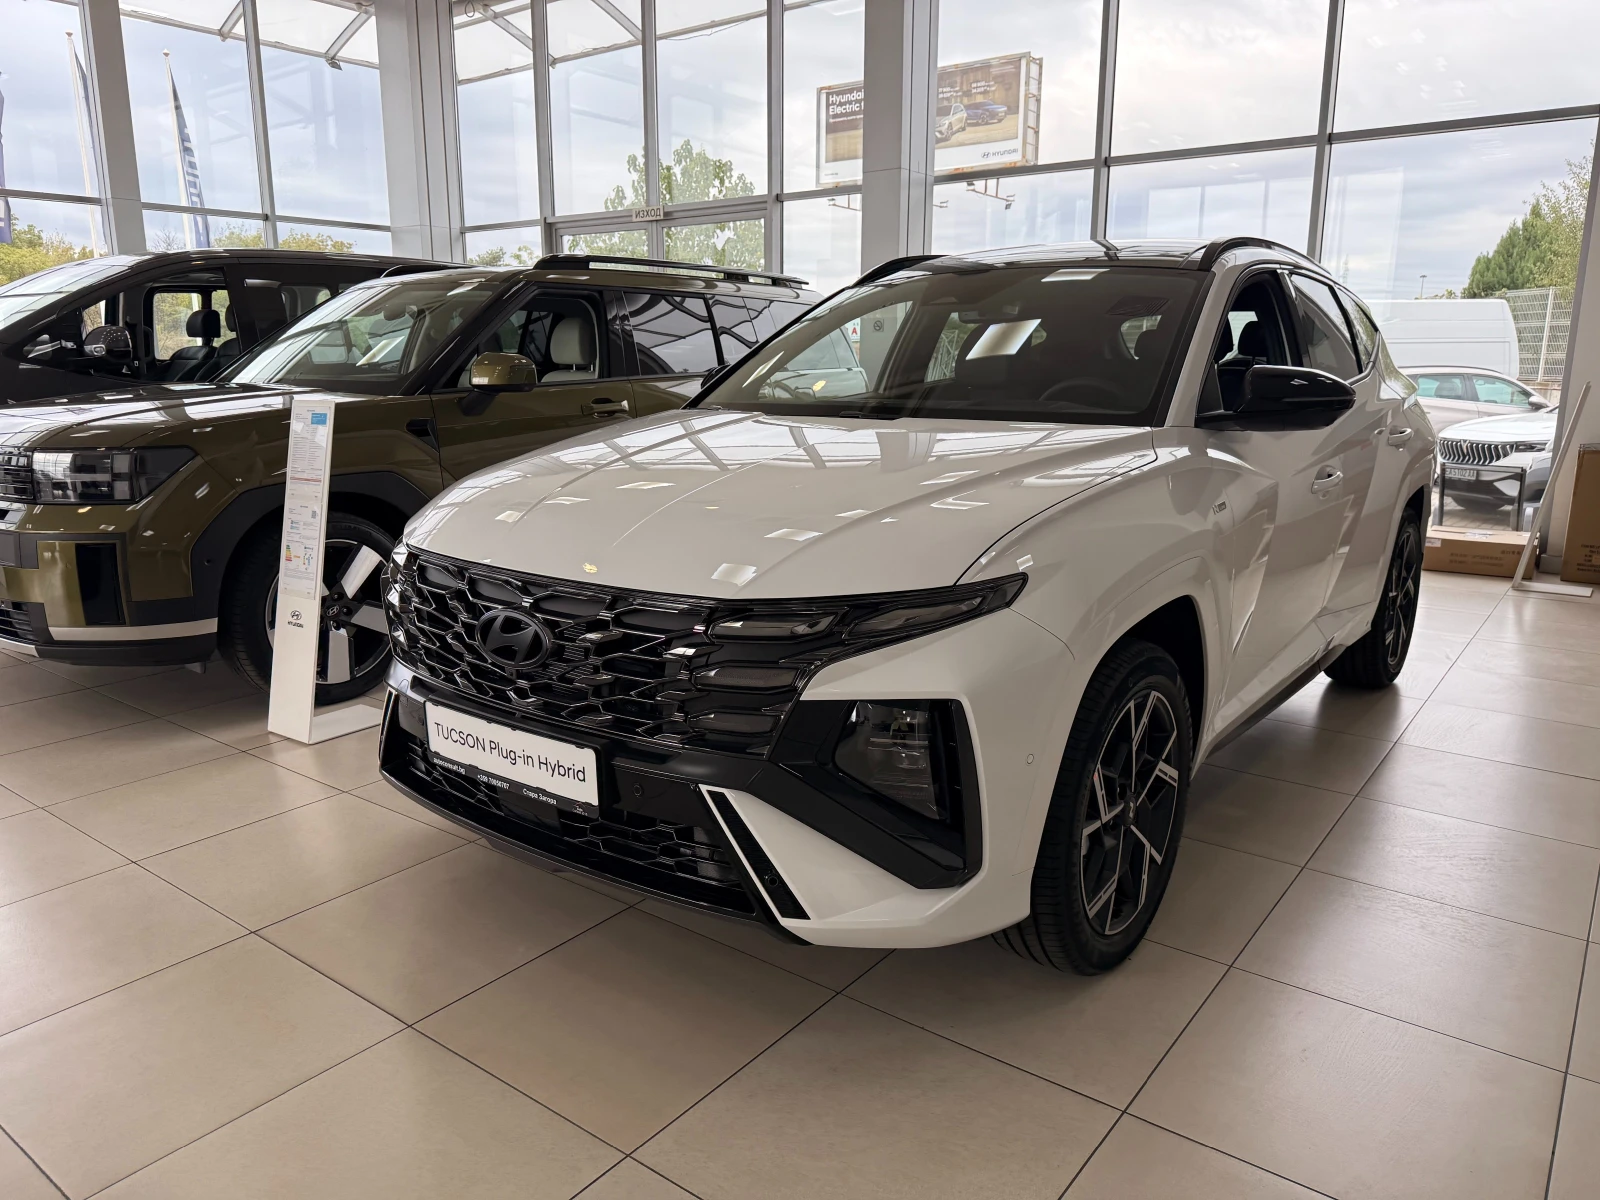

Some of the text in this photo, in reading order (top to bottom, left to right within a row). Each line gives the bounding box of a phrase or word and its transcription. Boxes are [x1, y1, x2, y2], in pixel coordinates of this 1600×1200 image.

[829, 89, 864, 105] Hyundai
[829, 102, 860, 115] Electric
[992, 148, 1019, 157] HYUNDAI
[635, 208, 661, 219] ИЗХОД
[434, 721, 586, 783] TUCSON Plug-in Hybrid
